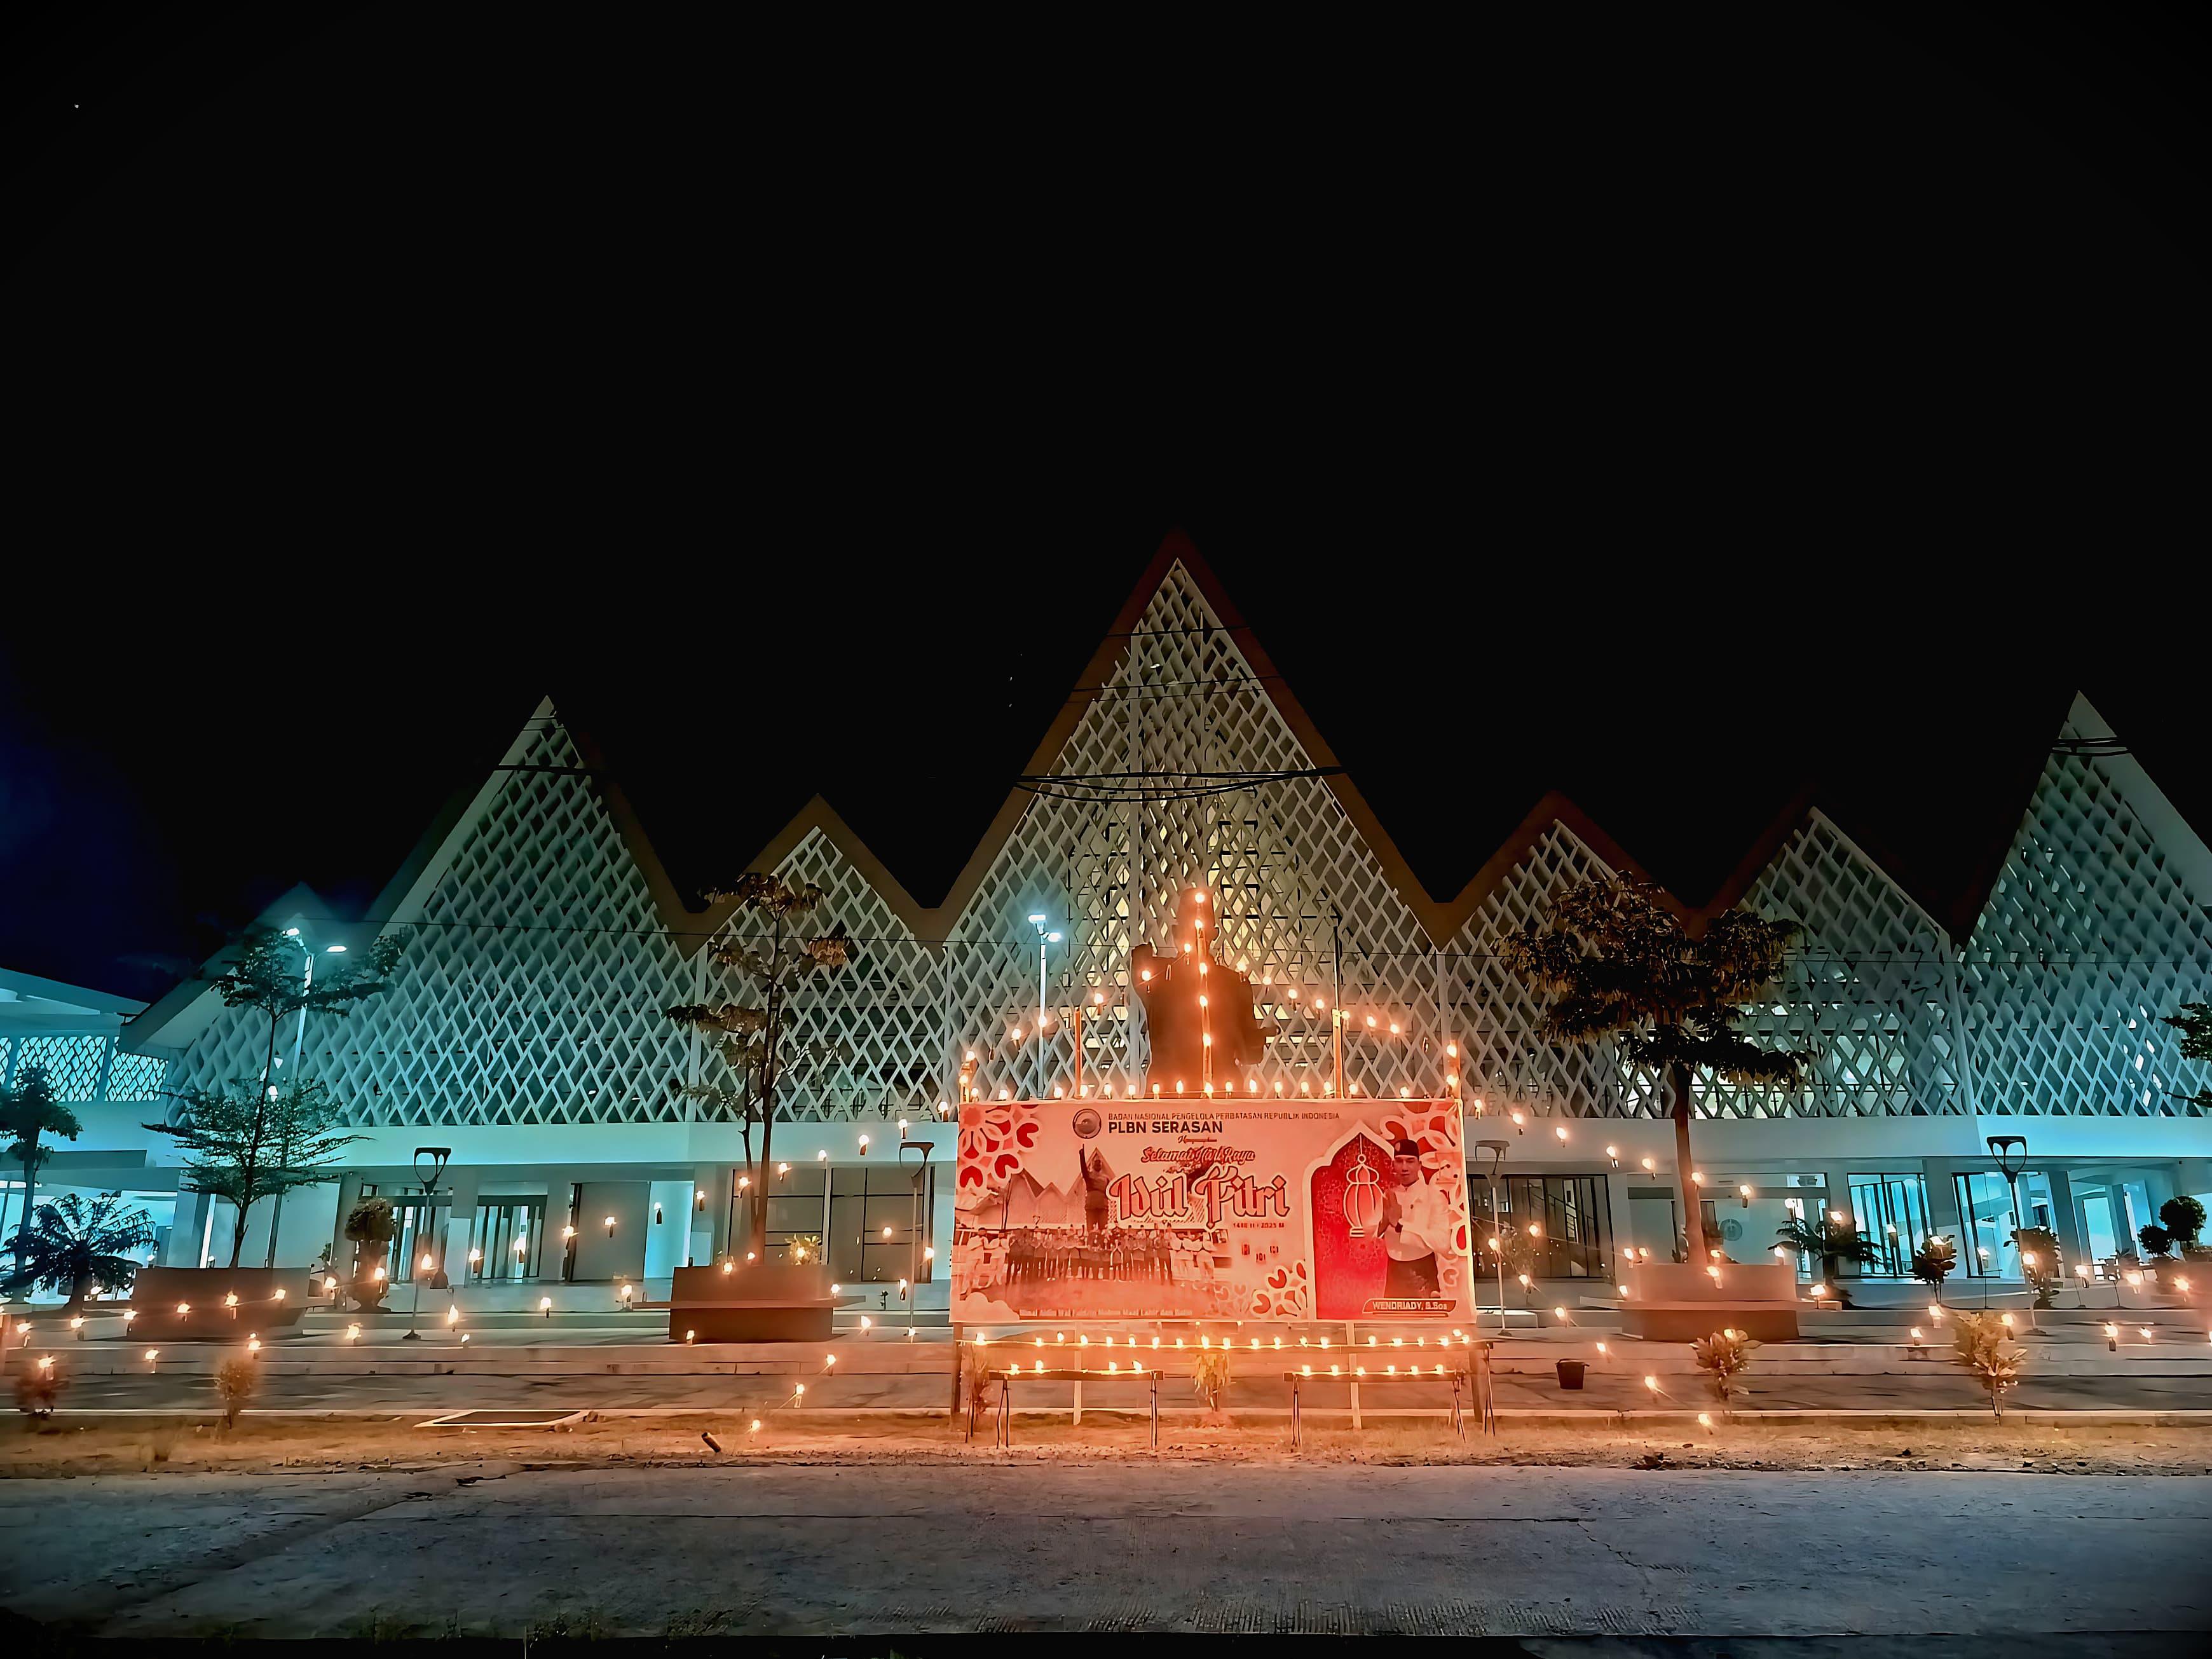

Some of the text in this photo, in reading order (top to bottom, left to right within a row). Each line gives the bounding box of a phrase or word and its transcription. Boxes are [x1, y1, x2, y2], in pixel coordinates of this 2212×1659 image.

[1108, 1121, 1223, 1134] PLBN SERASAN
[1141, 1146, 1196, 1163] Selamat
[1222, 1146, 1255, 1166] Raya
[1109, 1165, 1290, 1229] Idul Fitri
